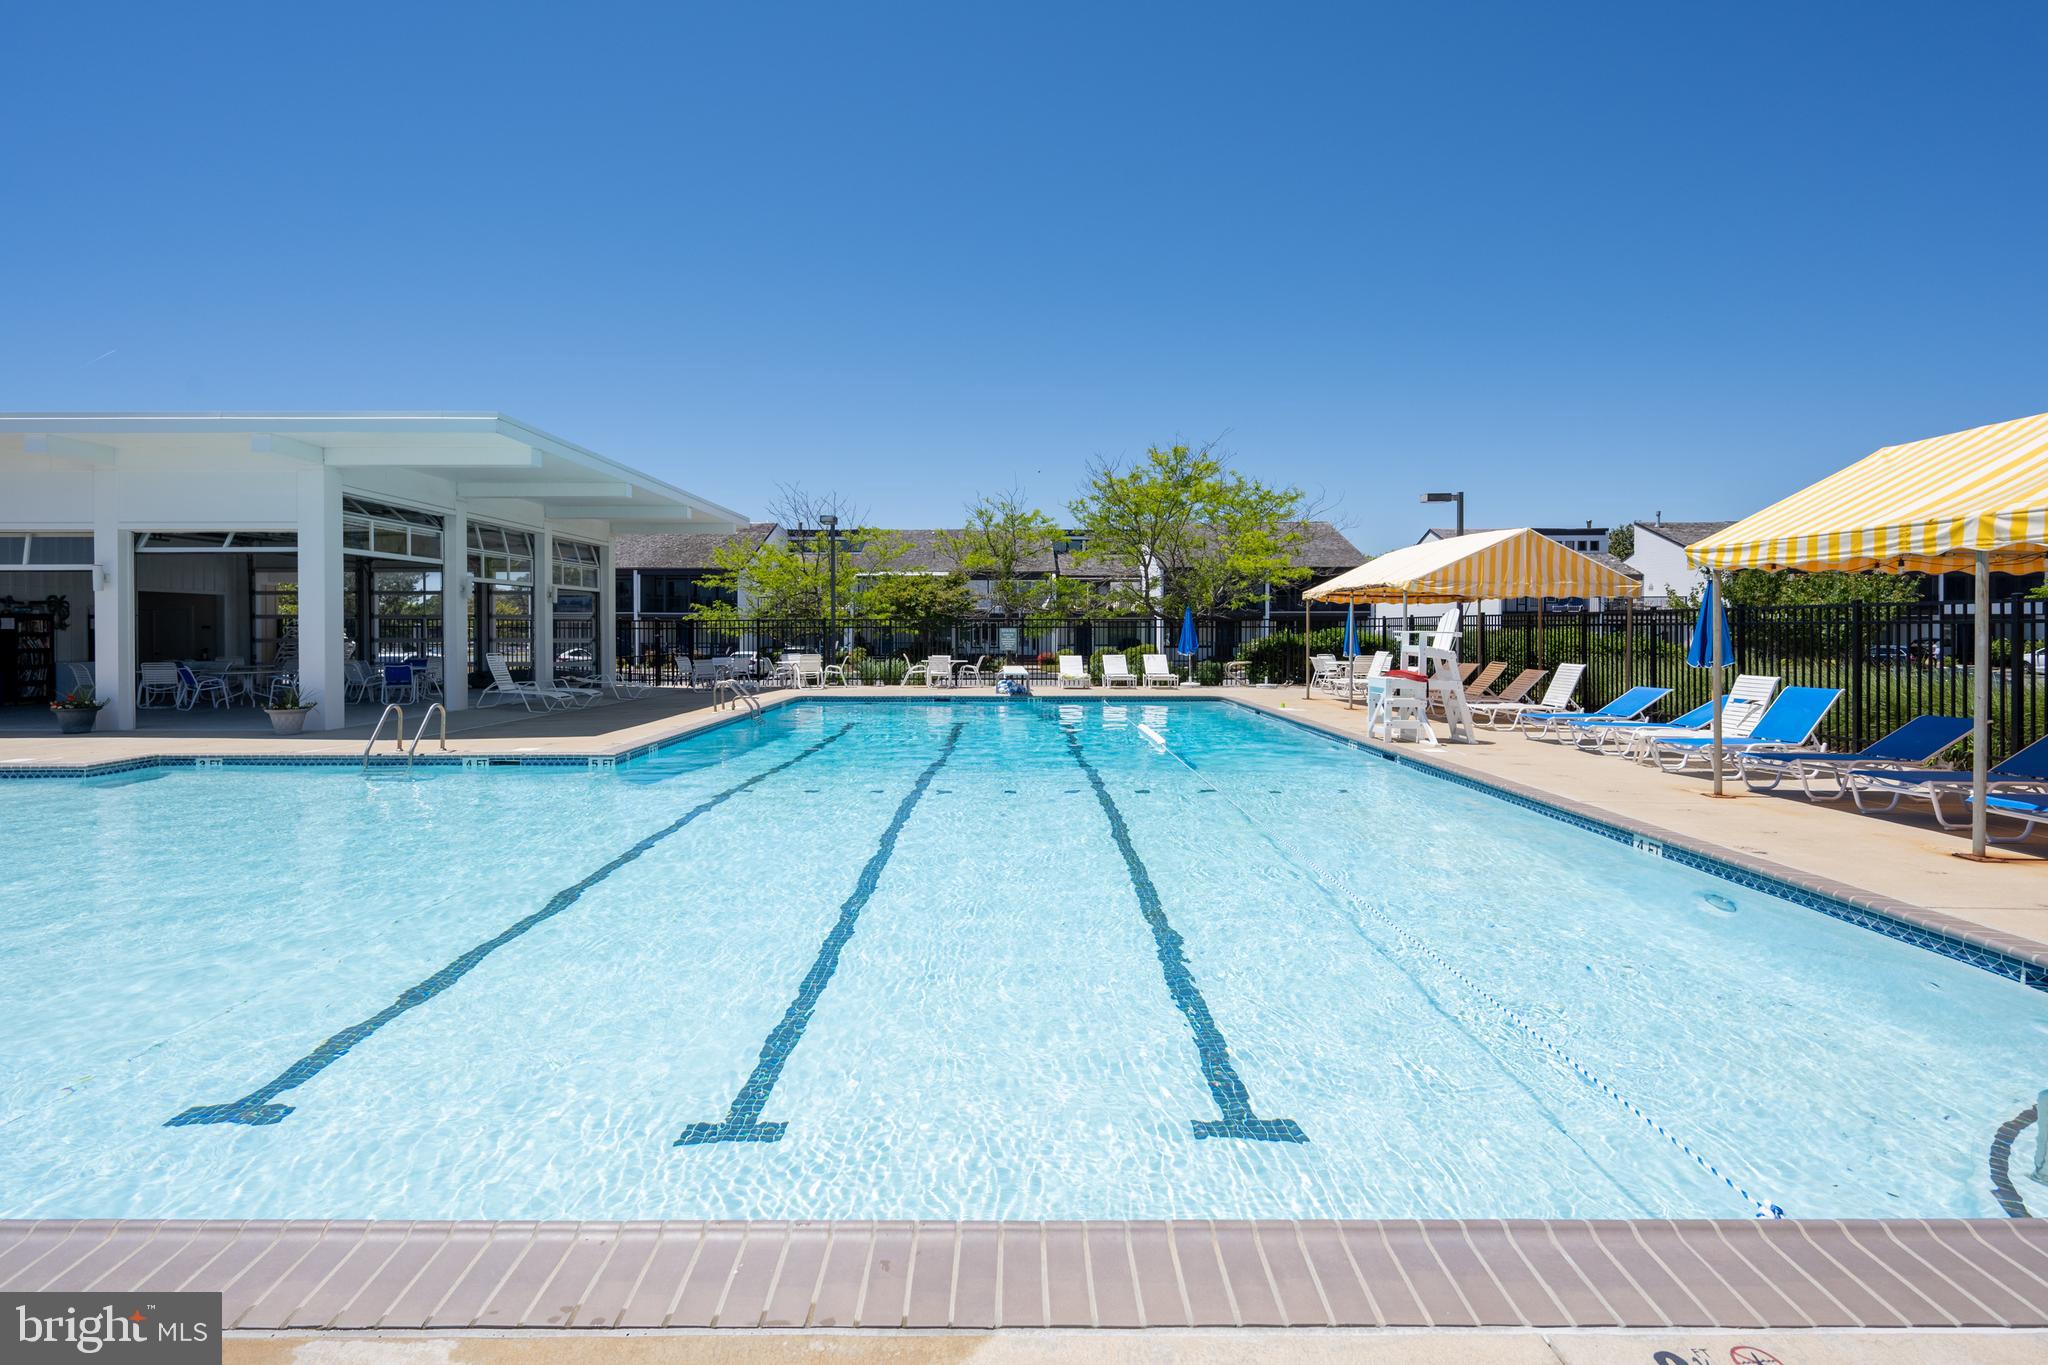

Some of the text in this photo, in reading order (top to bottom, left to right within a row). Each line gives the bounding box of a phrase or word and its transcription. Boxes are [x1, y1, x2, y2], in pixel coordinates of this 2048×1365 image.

[476, 759, 488, 767] FT
[602, 759, 614, 767] FT
[1647, 841, 1661, 855] FT
